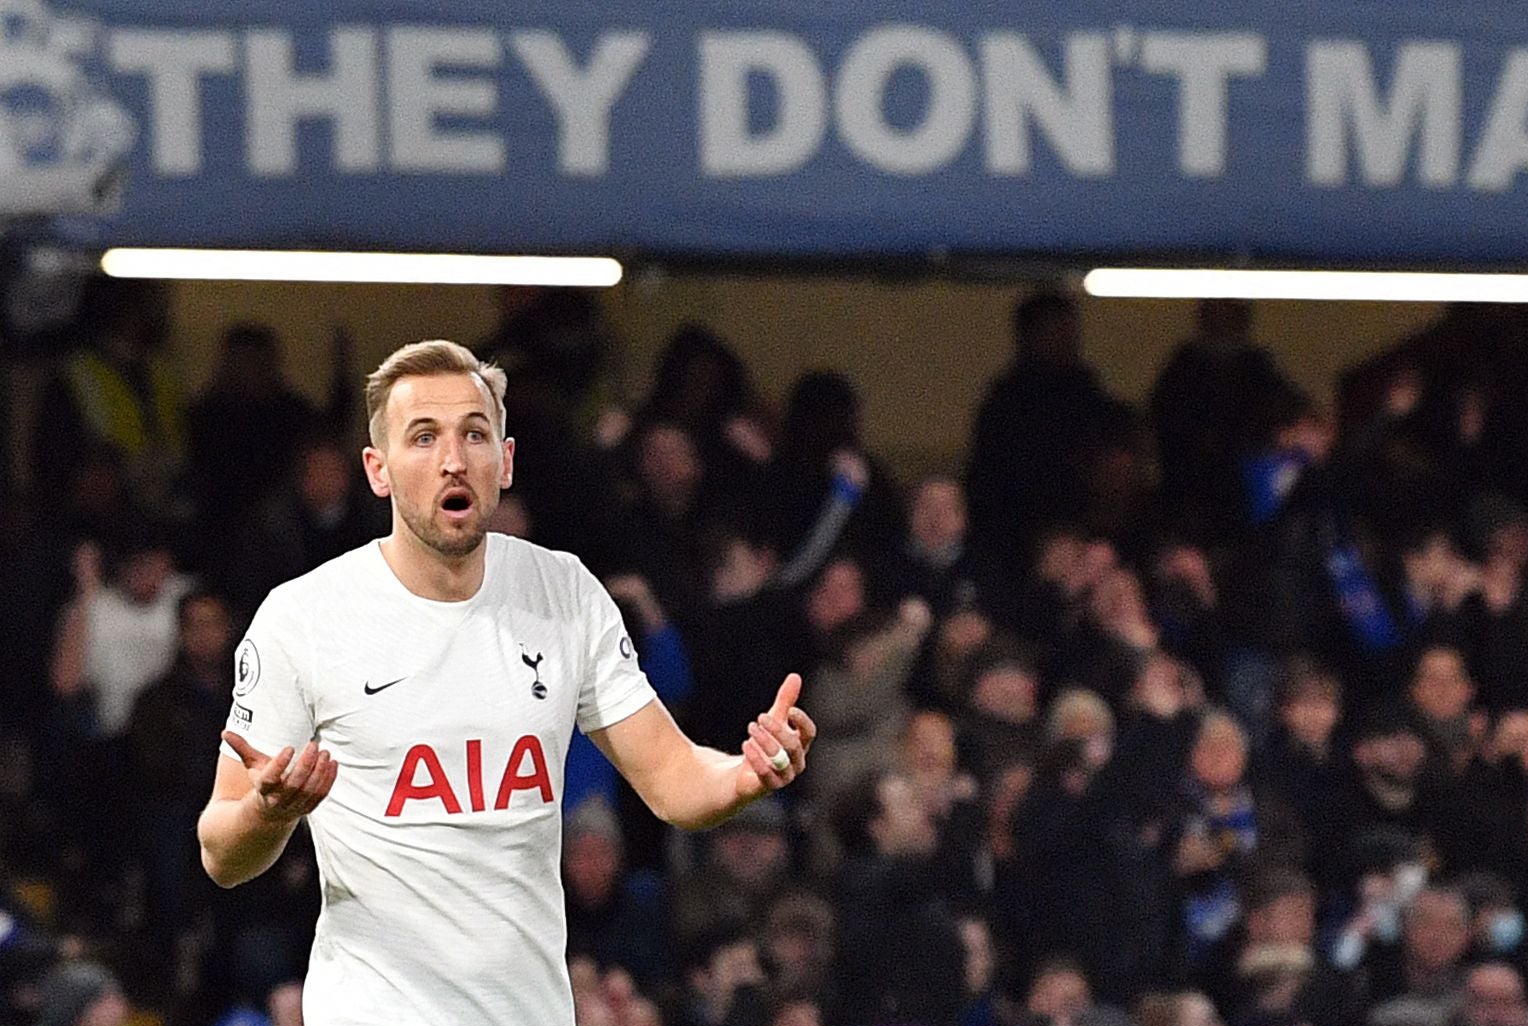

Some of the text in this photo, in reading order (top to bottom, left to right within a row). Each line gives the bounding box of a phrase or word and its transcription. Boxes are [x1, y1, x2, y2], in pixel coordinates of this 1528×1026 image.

[107, 26, 654, 177] THEY
[697, 22, 1268, 178] DON'T
[383, 733, 556, 818] AIA
